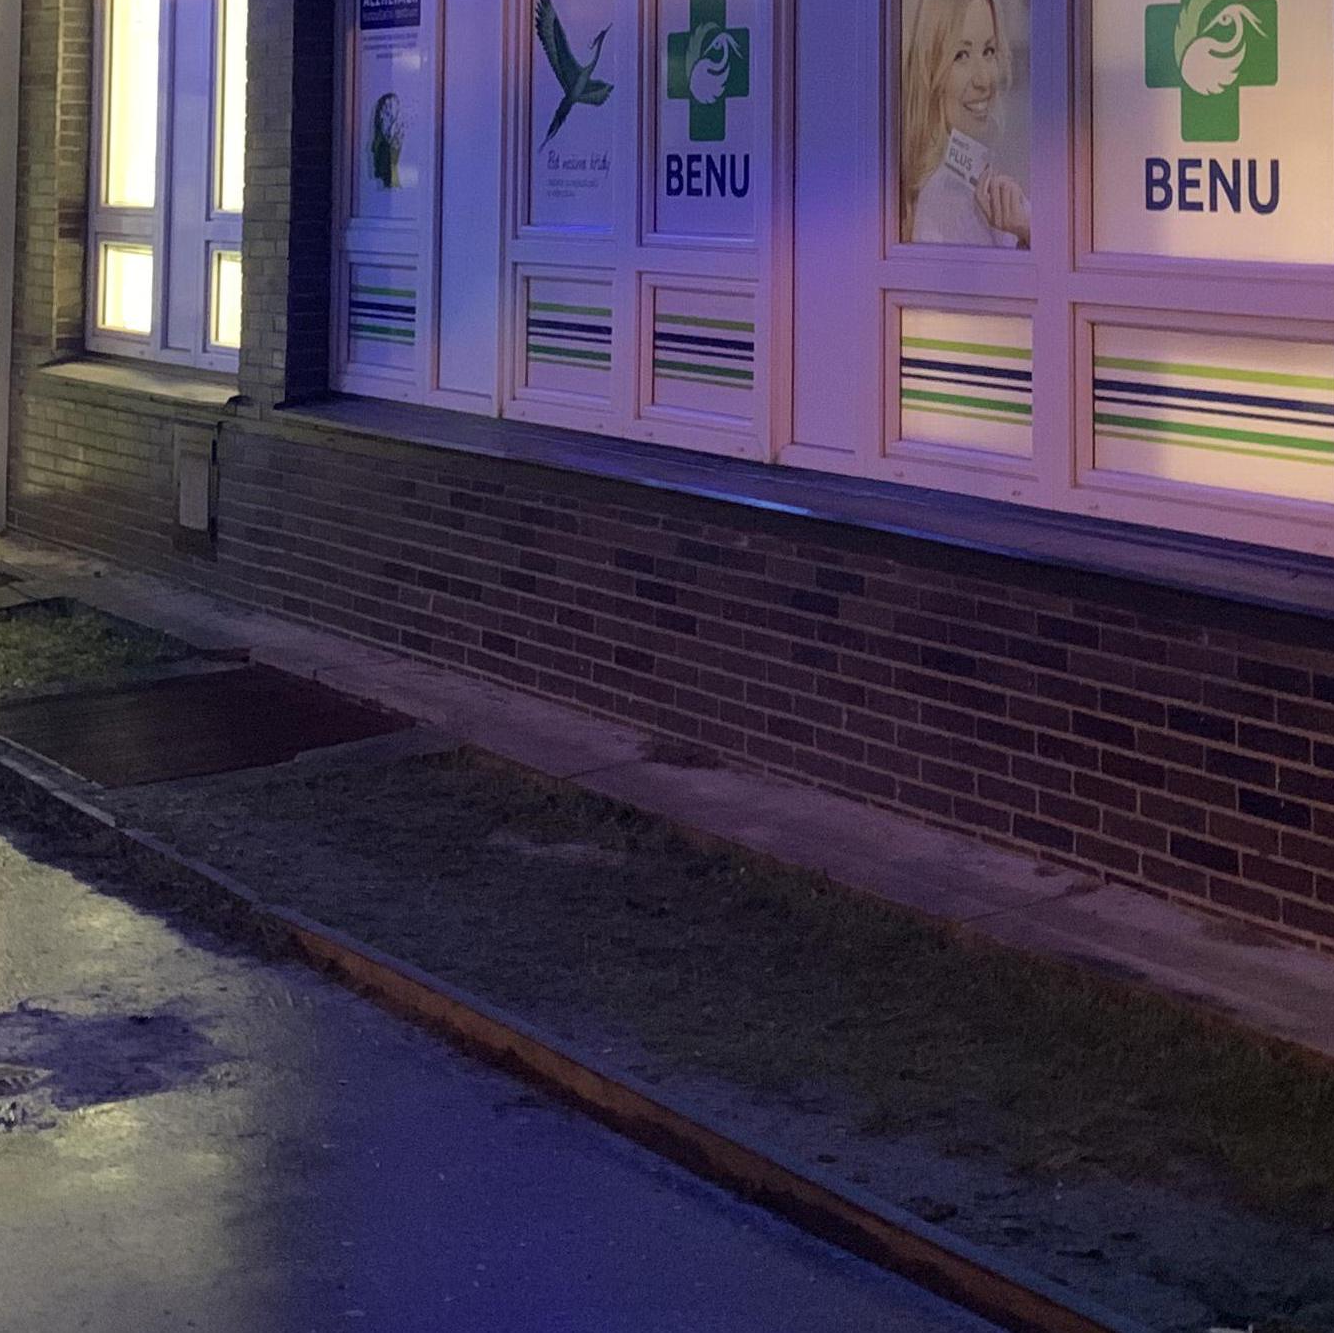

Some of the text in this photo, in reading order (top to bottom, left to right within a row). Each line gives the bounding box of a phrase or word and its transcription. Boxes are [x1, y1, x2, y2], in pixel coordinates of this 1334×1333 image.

[666, 153, 750, 199] BENU
[949, 147, 973, 172] PLUS
[1145, 157, 1280, 215] BENU
